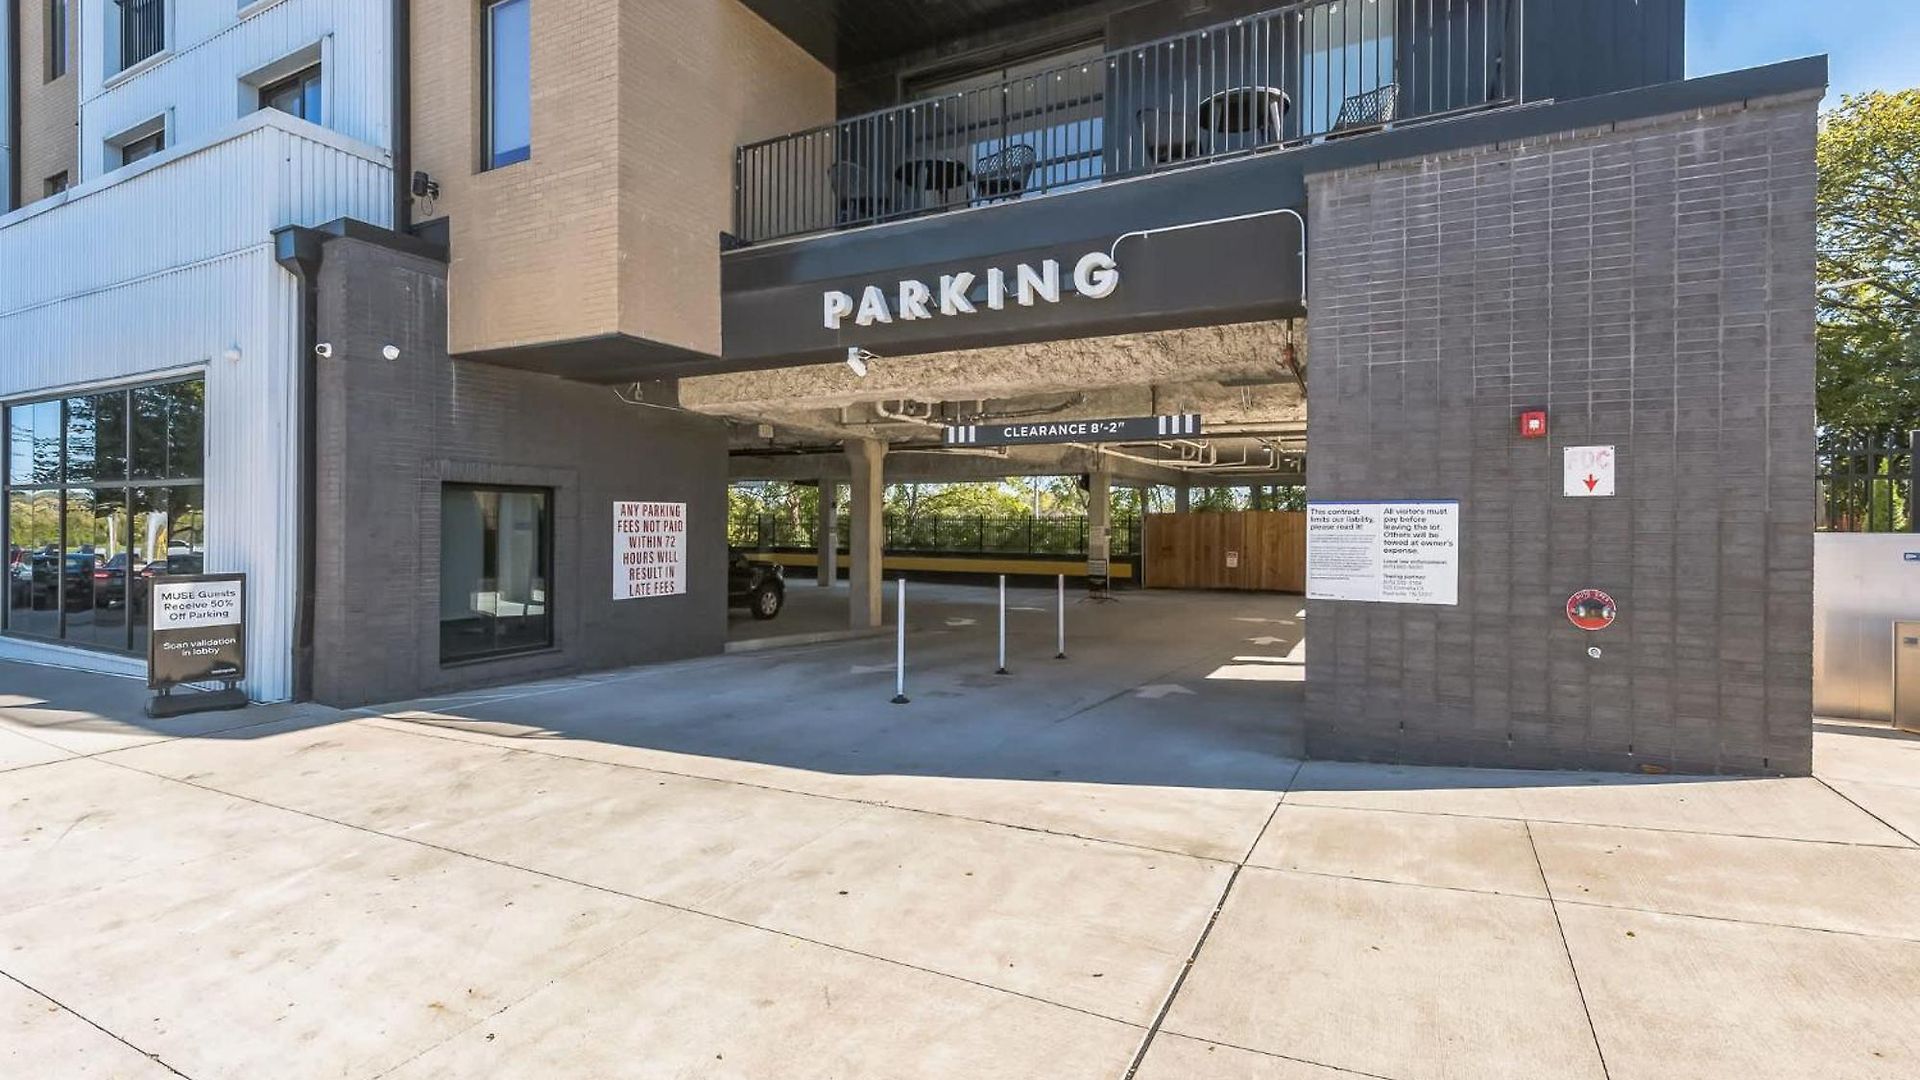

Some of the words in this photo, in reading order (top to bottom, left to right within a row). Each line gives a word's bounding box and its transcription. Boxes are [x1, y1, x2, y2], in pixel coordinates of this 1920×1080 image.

[824, 252, 1120, 329] PARKING
[1004, 423, 1087, 438] CLEARANCE
[620, 504, 640, 517] ANY
[642, 504, 681, 517] PARKING
[617, 520, 640, 533] FEES
[643, 520, 661, 533] NOT
[663, 520, 684, 532] PAID
[629, 536, 663, 548] WITHIN
[665, 536, 676, 547] 72
[1420, 539, 1454, 547] owner's
[623, 551, 654, 565] HOURS
[657, 551, 679, 563] WILL
[629, 567, 662, 581] RESULT
[665, 566, 675, 578] IN
[162, 591, 195, 601] MUSE
[198, 589, 236, 599] Guests
[629, 583, 651, 597] LATE
[654, 581, 675, 594] FEES
[164, 602, 208, 611] Receive
[210, 599, 234, 608] 50%
[169, 611, 186, 620] Off
[189, 609, 230, 620] Parking
[163, 641, 189, 650] Scan
[190, 637, 237, 648] validation
[182, 647, 191, 656] in
[192, 646, 220, 656] lobby
